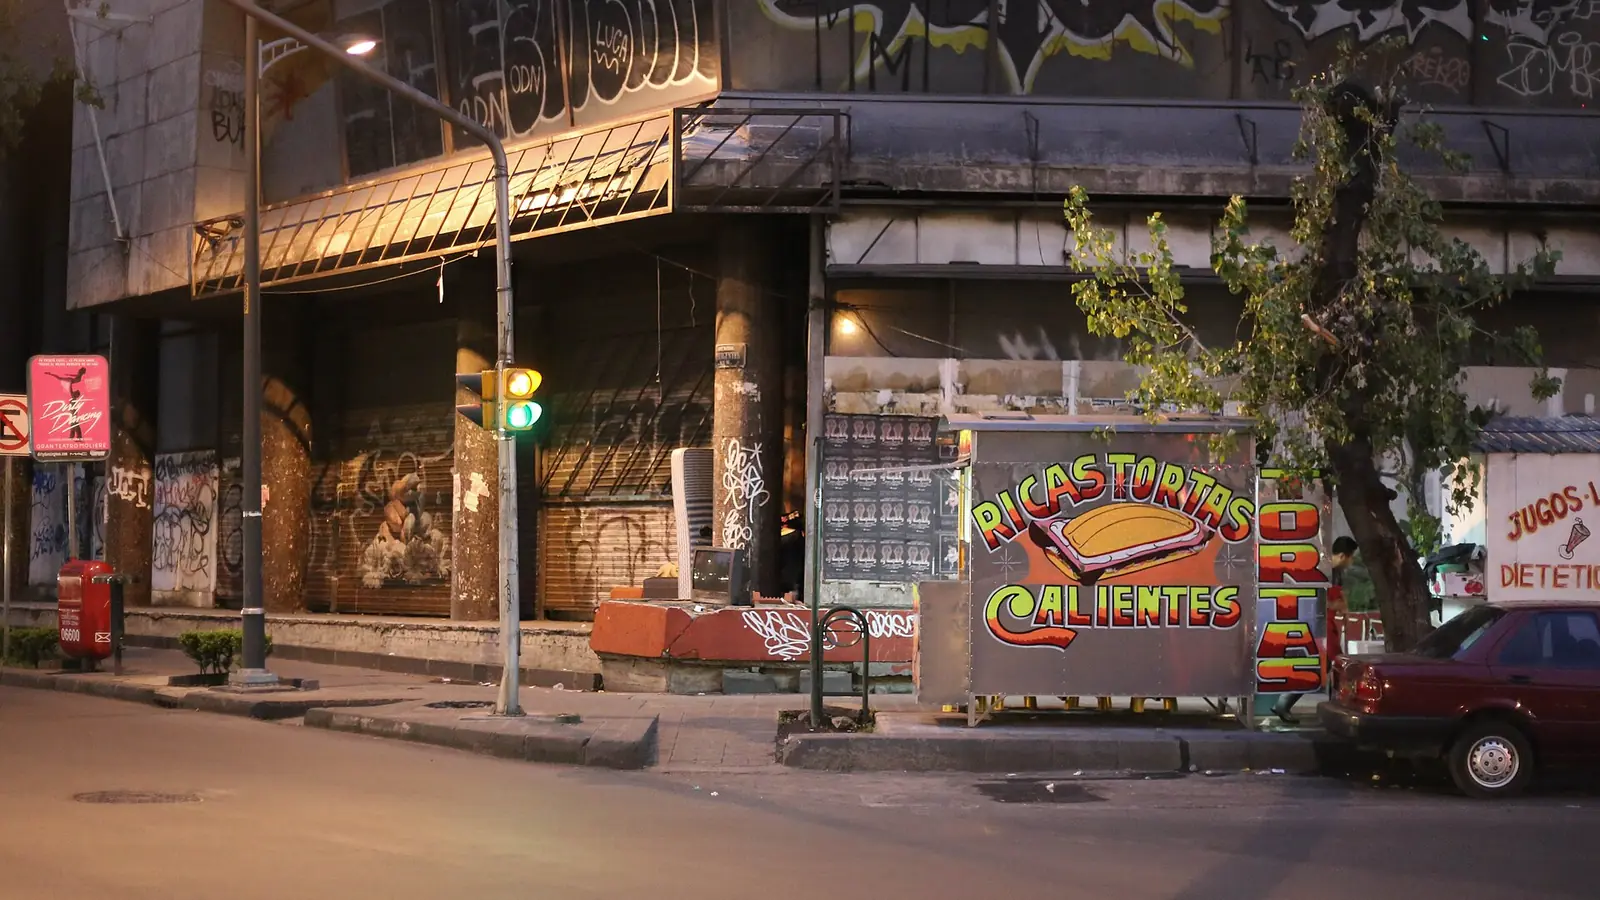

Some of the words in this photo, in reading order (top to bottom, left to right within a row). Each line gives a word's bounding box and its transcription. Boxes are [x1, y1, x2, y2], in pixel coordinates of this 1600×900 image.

[596, 21, 628, 62] LUCA
[510, 65, 541, 95] ODN
[40, 395, 94, 420] Dirty
[47, 406, 102, 435] Dancing
[972, 453, 1106, 552] RICAS
[1104, 453, 1256, 544] TORTAS
[1256, 467, 1330, 694] TORTAS
[61, 628, 80, 642] 06600
[983, 584, 1242, 652] CALIENTES
